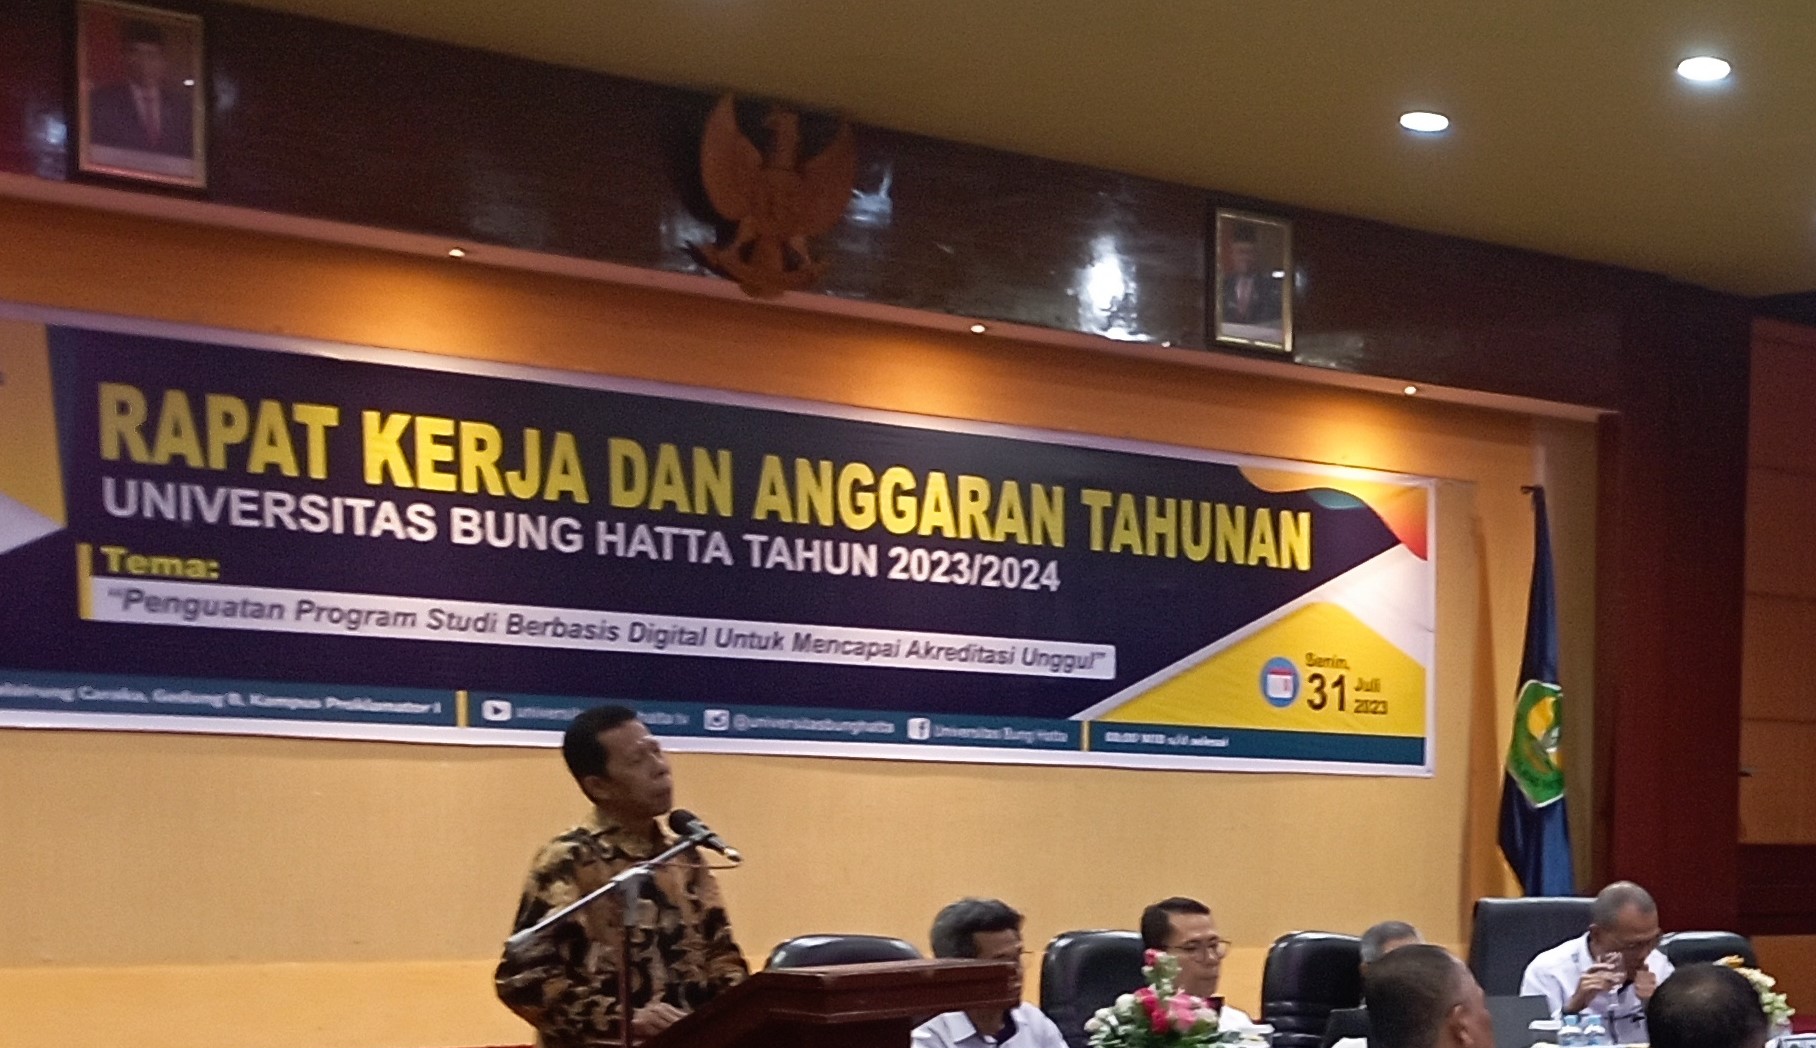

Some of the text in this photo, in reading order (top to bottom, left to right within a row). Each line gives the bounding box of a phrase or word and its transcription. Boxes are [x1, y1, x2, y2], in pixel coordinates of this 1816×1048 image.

[99, 382, 1311, 572] RAPAT KERJA DAN ANGGARAN TAHUNAN
[102, 476, 1061, 592] UNIVERSITAS BUNG HATTA TAHUN 2023/2024
[100, 545, 220, 581] Tema:
[294, 599, 418, 632] Program
[426, 607, 498, 634] Studi
[505, 612, 621, 643] Berbasis
[627, 620, 708, 650] Digital
[714, 626, 785, 652] Untuk
[792, 632, 902, 661] Mencapai
[905, 639, 1015, 666] Akreditasi
[1306, 672, 1381, 712] 31 Juli
[1353, 699, 1389, 716] 2023
